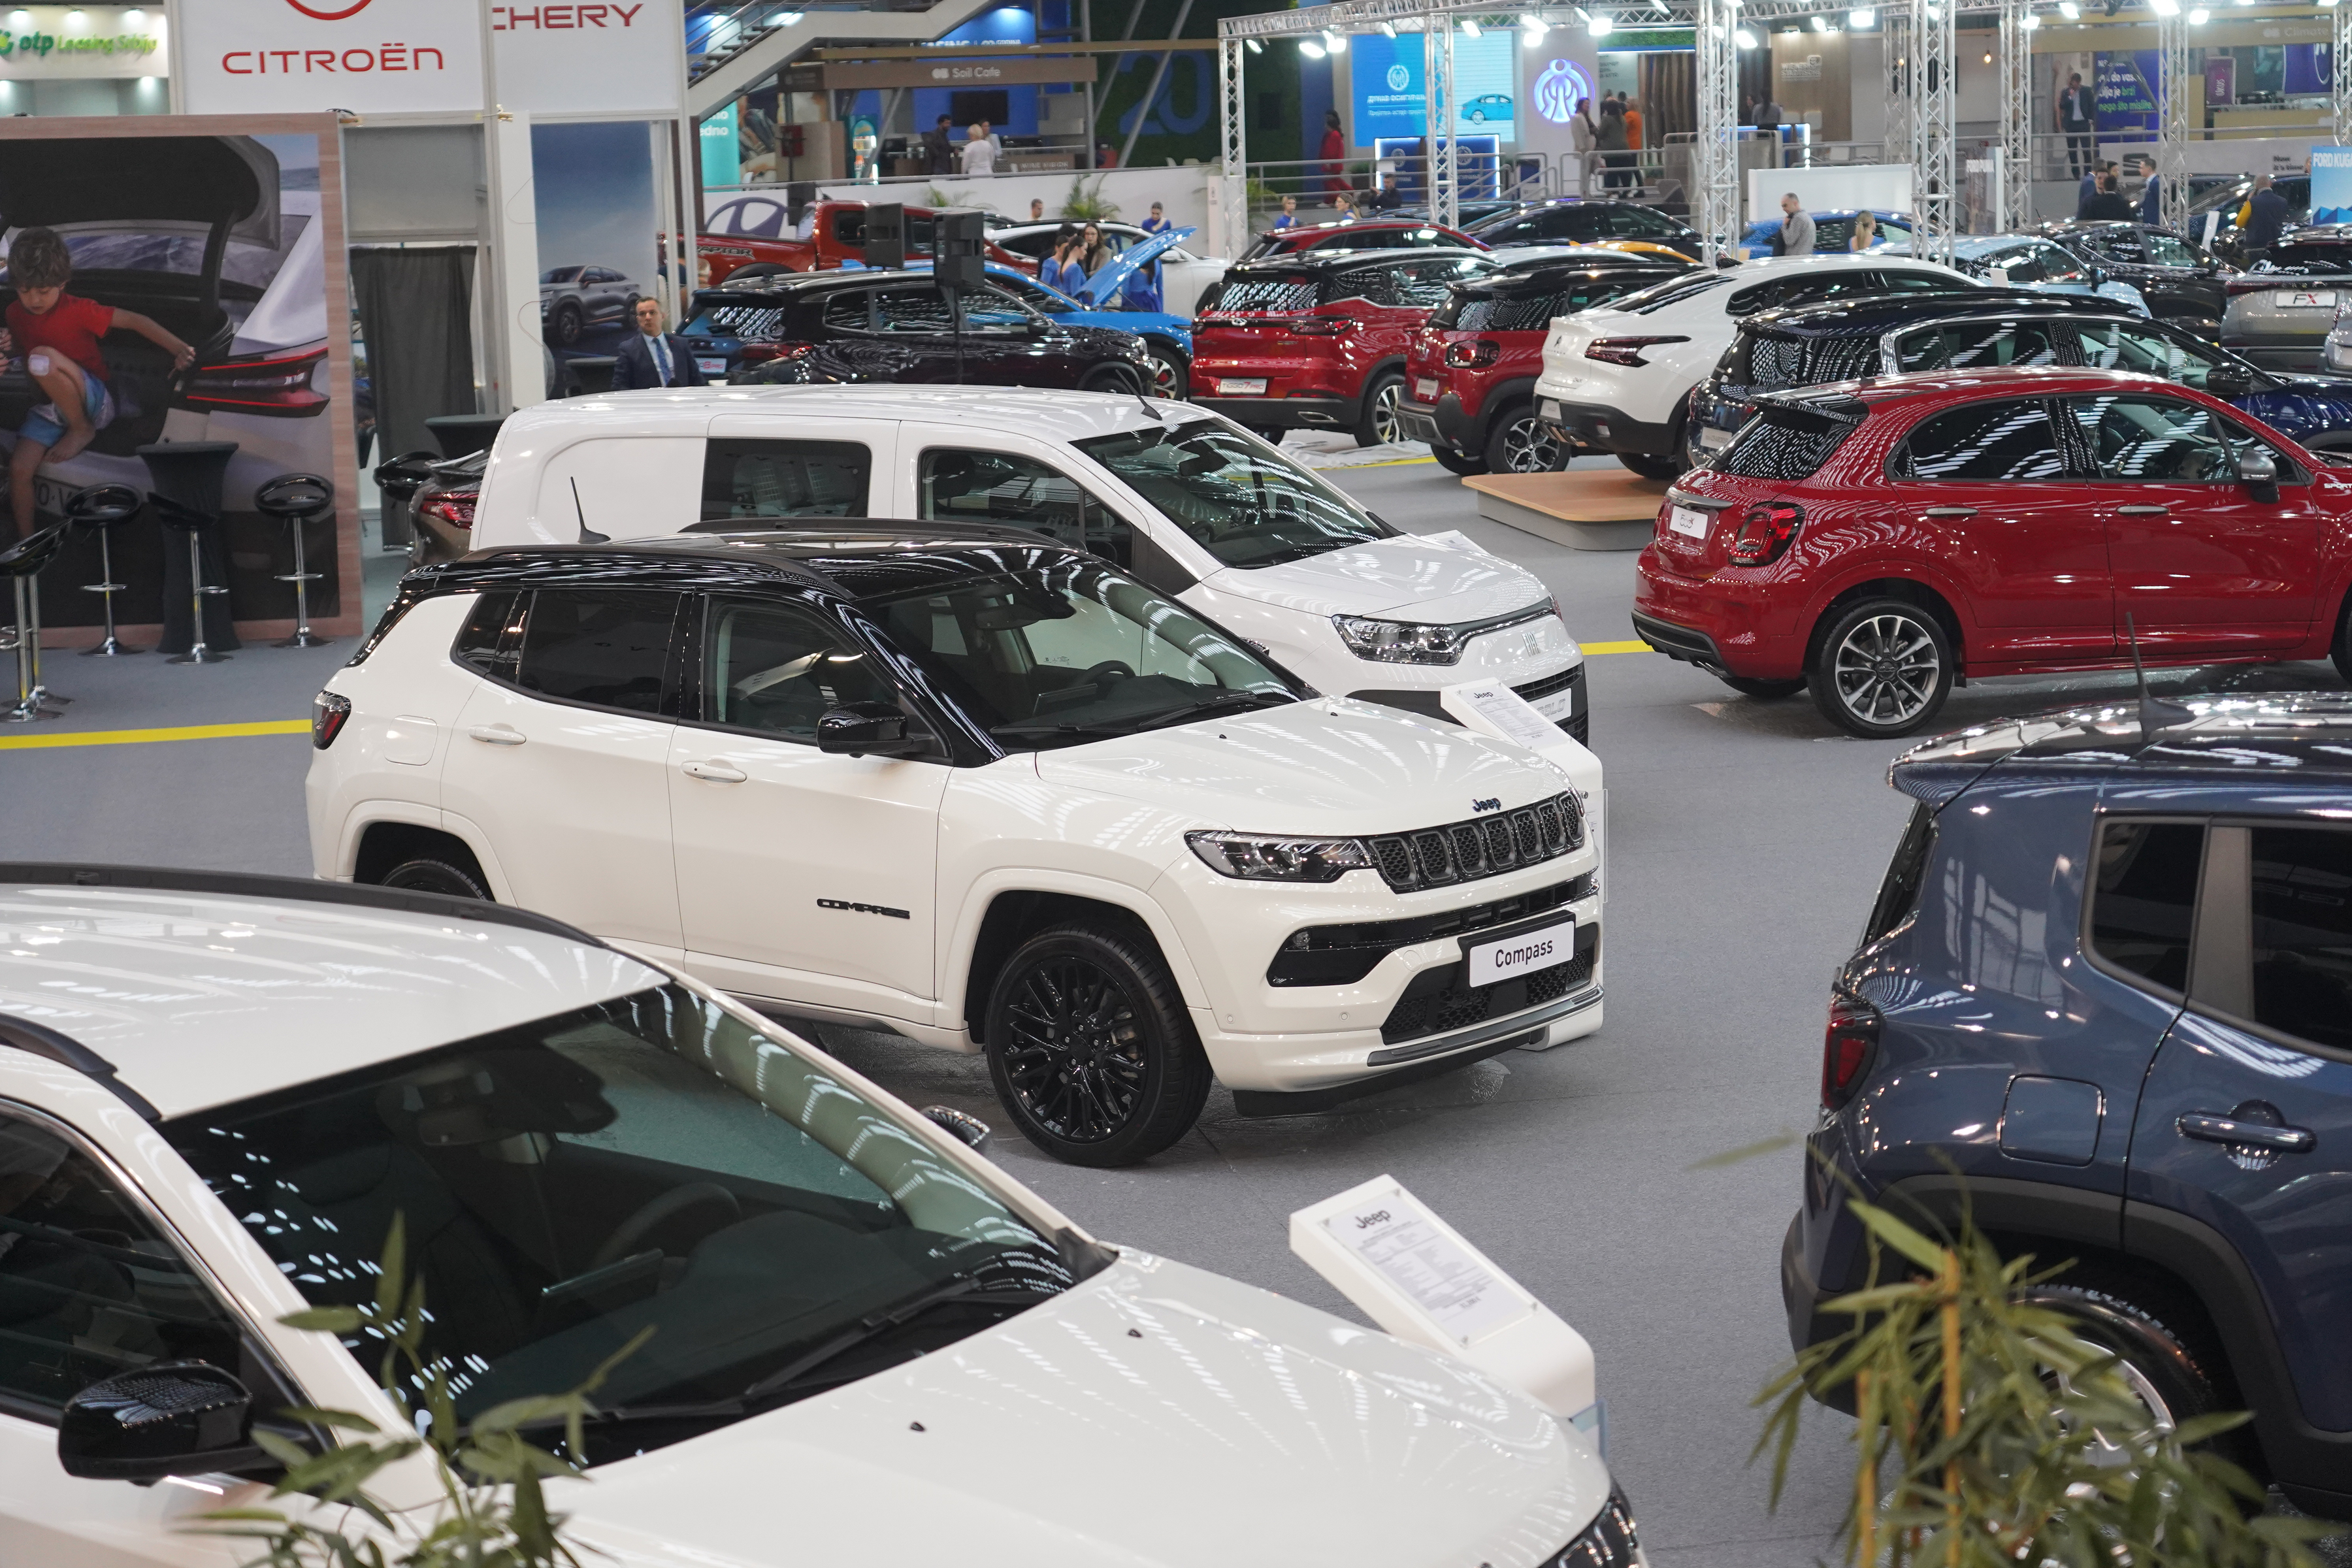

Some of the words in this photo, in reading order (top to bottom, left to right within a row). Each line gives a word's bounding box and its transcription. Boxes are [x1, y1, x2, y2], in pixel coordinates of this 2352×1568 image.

[19, 31, 54, 56] otp
[57, 33, 114, 54] Leasing
[222, 42, 444, 74] CITROËN
[952, 67, 973, 78] Soil
[973, 67, 1001, 77] Cafe
[2312, 152, 2333, 168] FORD
[2293, 293, 2319, 304] FX
[1521, 630, 1541, 657] FIAT
[1472, 797, 1501, 813] Jeep
[817, 898, 910, 920] COMPASS
[1495, 939, 1553, 968] Compass
[1355, 1209, 1391, 1229] Jeep
